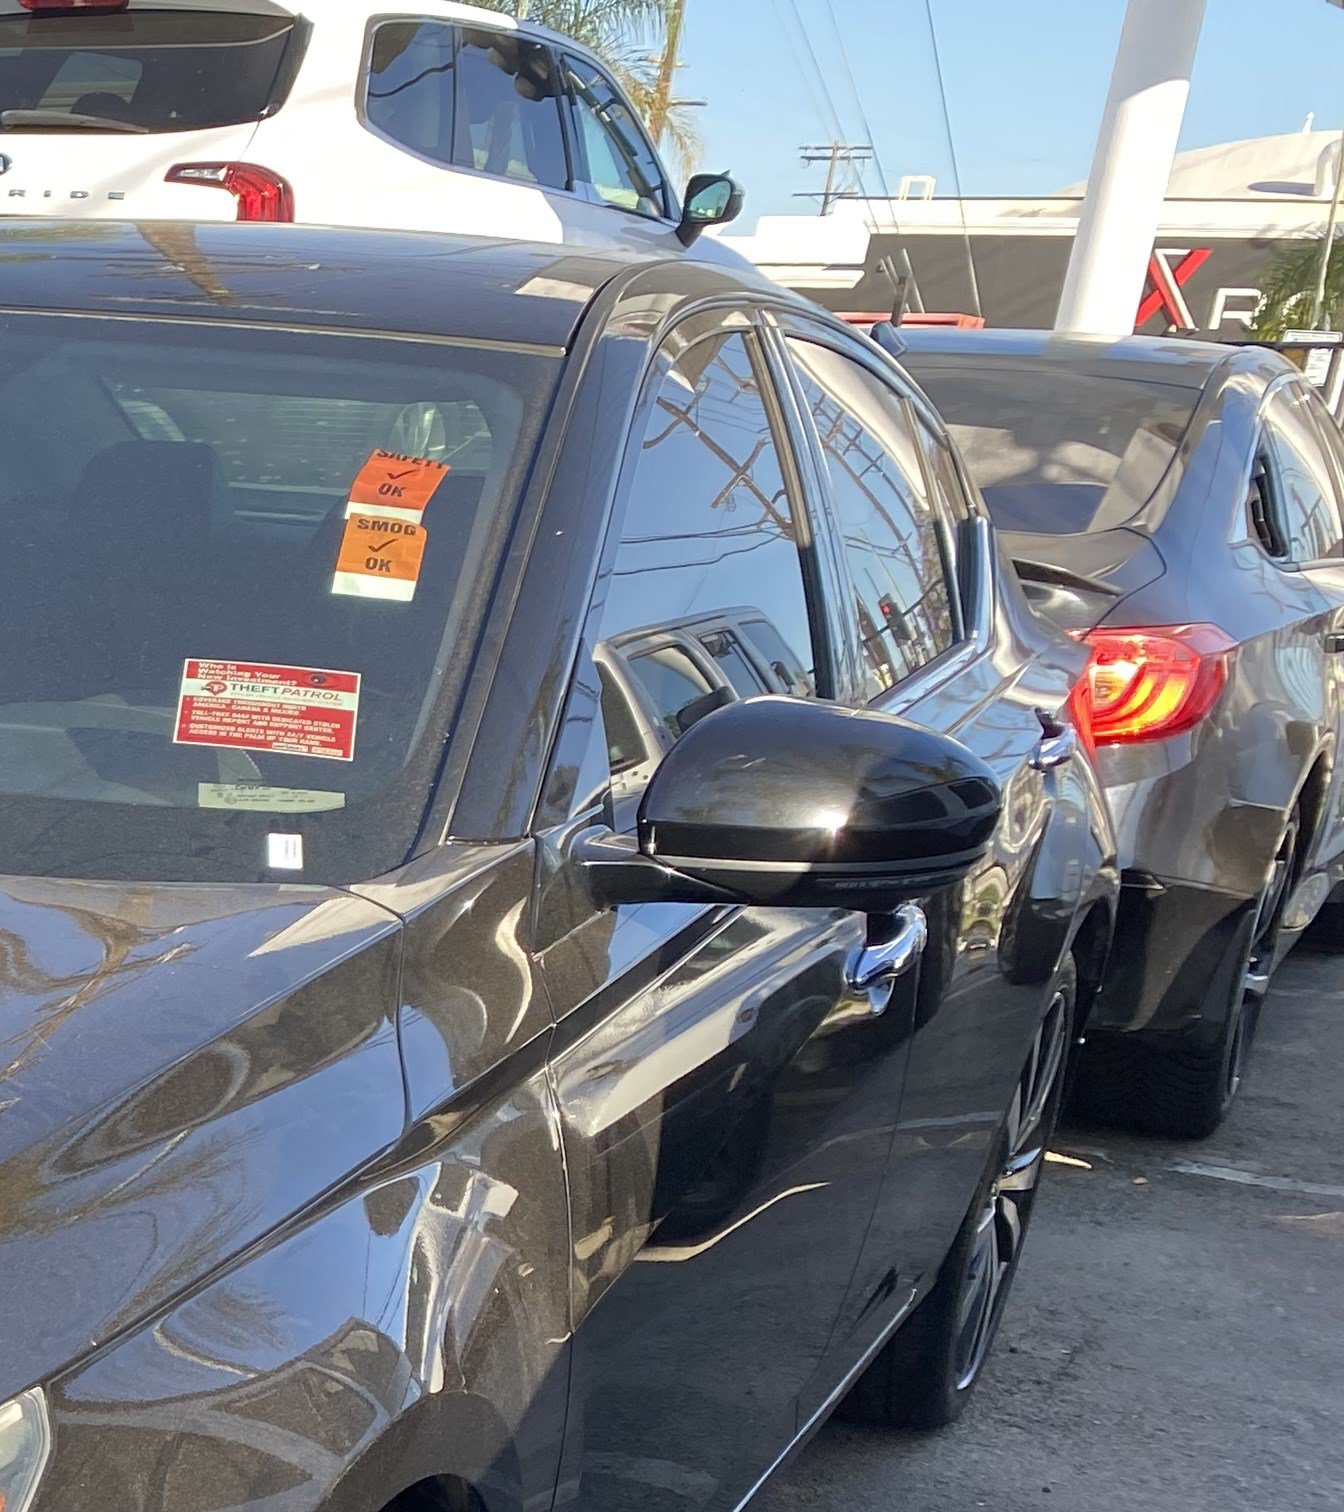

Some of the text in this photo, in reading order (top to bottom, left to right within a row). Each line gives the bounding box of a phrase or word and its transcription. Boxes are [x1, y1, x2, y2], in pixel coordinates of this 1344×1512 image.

[378, 483, 407, 497] OK
[357, 518, 417, 536] SMOG
[365, 557, 392, 572] OK
[197, 666, 251, 677] Watching
[226, 674, 297, 686] Investment?
